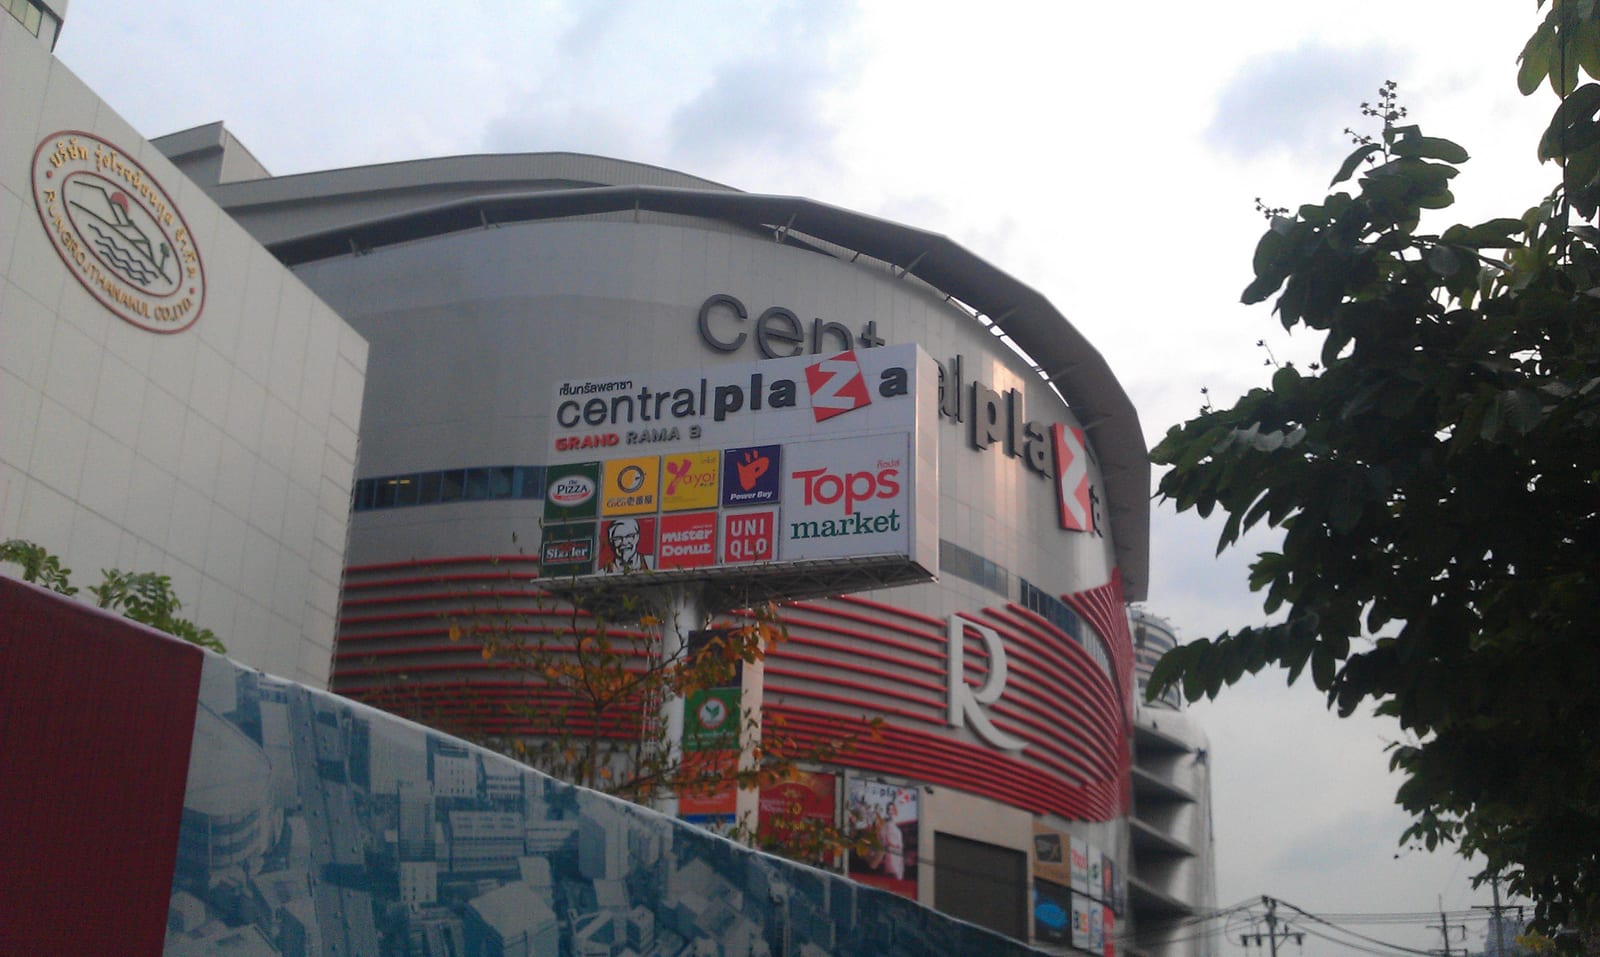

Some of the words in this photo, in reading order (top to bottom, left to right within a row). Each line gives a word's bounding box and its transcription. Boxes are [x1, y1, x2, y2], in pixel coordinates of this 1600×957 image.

[555, 433, 619, 452] GRAND
[626, 427, 680, 445] RAMA
[557, 484, 588, 495] PIZZA
[730, 492, 756, 501] Power
[756, 490, 773, 500] Buy
[791, 467, 900, 516] Tops
[730, 518, 765, 537] UNI
[790, 508, 900, 540] market
[730, 538, 768, 559] QLO
